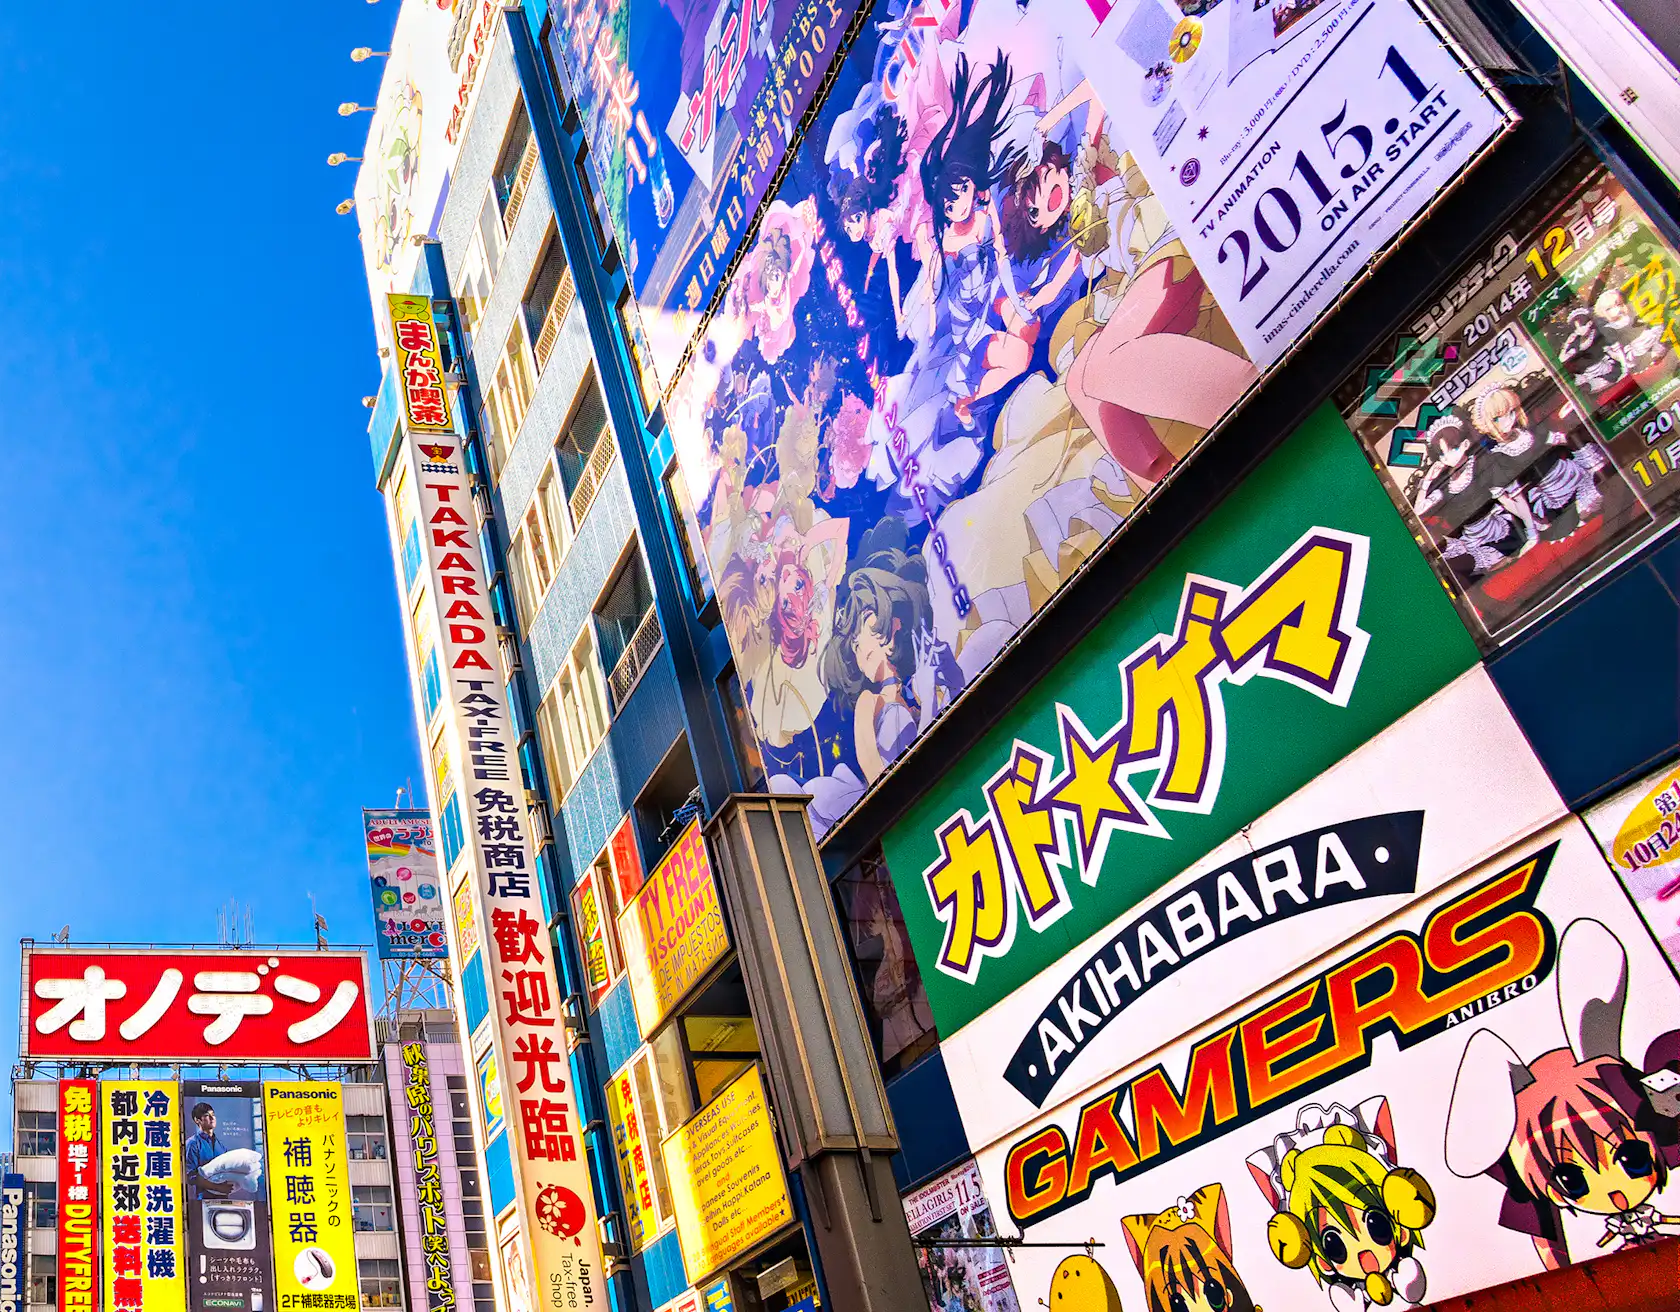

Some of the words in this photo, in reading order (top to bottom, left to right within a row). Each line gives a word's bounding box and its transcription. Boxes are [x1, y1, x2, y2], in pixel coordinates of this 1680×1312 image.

[1199, 218, 1216, 240] TV
[1217, 140, 1282, 220] ANIMATION
[1217, 44, 1438, 303] 2015.1
[1320, 199, 1349, 232] ON
[1351, 162, 1385, 202] AIR
[1386, 89, 1449, 162] START
[1261, 237, 1362, 346] imas-cinderella.com
[1463, 274, 1533, 347] 2014年
[396, 319, 447, 426] まんが喫茶
[425, 483, 494, 671] TAKARADA
[457, 679, 510, 781] TAX-FREE
[473, 787, 531, 898] 免税商店
[661, 825, 711, 919] FREE
[646, 878, 713, 974] DISCOUNT
[671, 905, 720, 971] IMPUESTOS
[1039, 832, 1367, 1076] AKIHABARA
[34, 957, 361, 1046] オノデン
[1004, 845, 1558, 1221] GAMERS
[1444, 974, 1538, 1031] ANIBRO
[64, 1086, 93, 1142] 免税
[201, 1085, 243, 1094] Panasonic
[269, 1104, 323, 1121] テレビの音も
[270, 1088, 338, 1100] Panasonic
[297, 1112, 340, 1128] よりキレイ
[110, 1090, 144, 1312] 都内・近郊送料無
[143, 1090, 176, 1280] 冷蔵庫洗濯機
[283, 1136, 318, 1244] 補聴器
[323, 1134, 341, 1228] パナソニックの
[210, 1256, 255, 1266] シーツや毛布も
[282, 1294, 357, 1310] 2F補聴器売場
